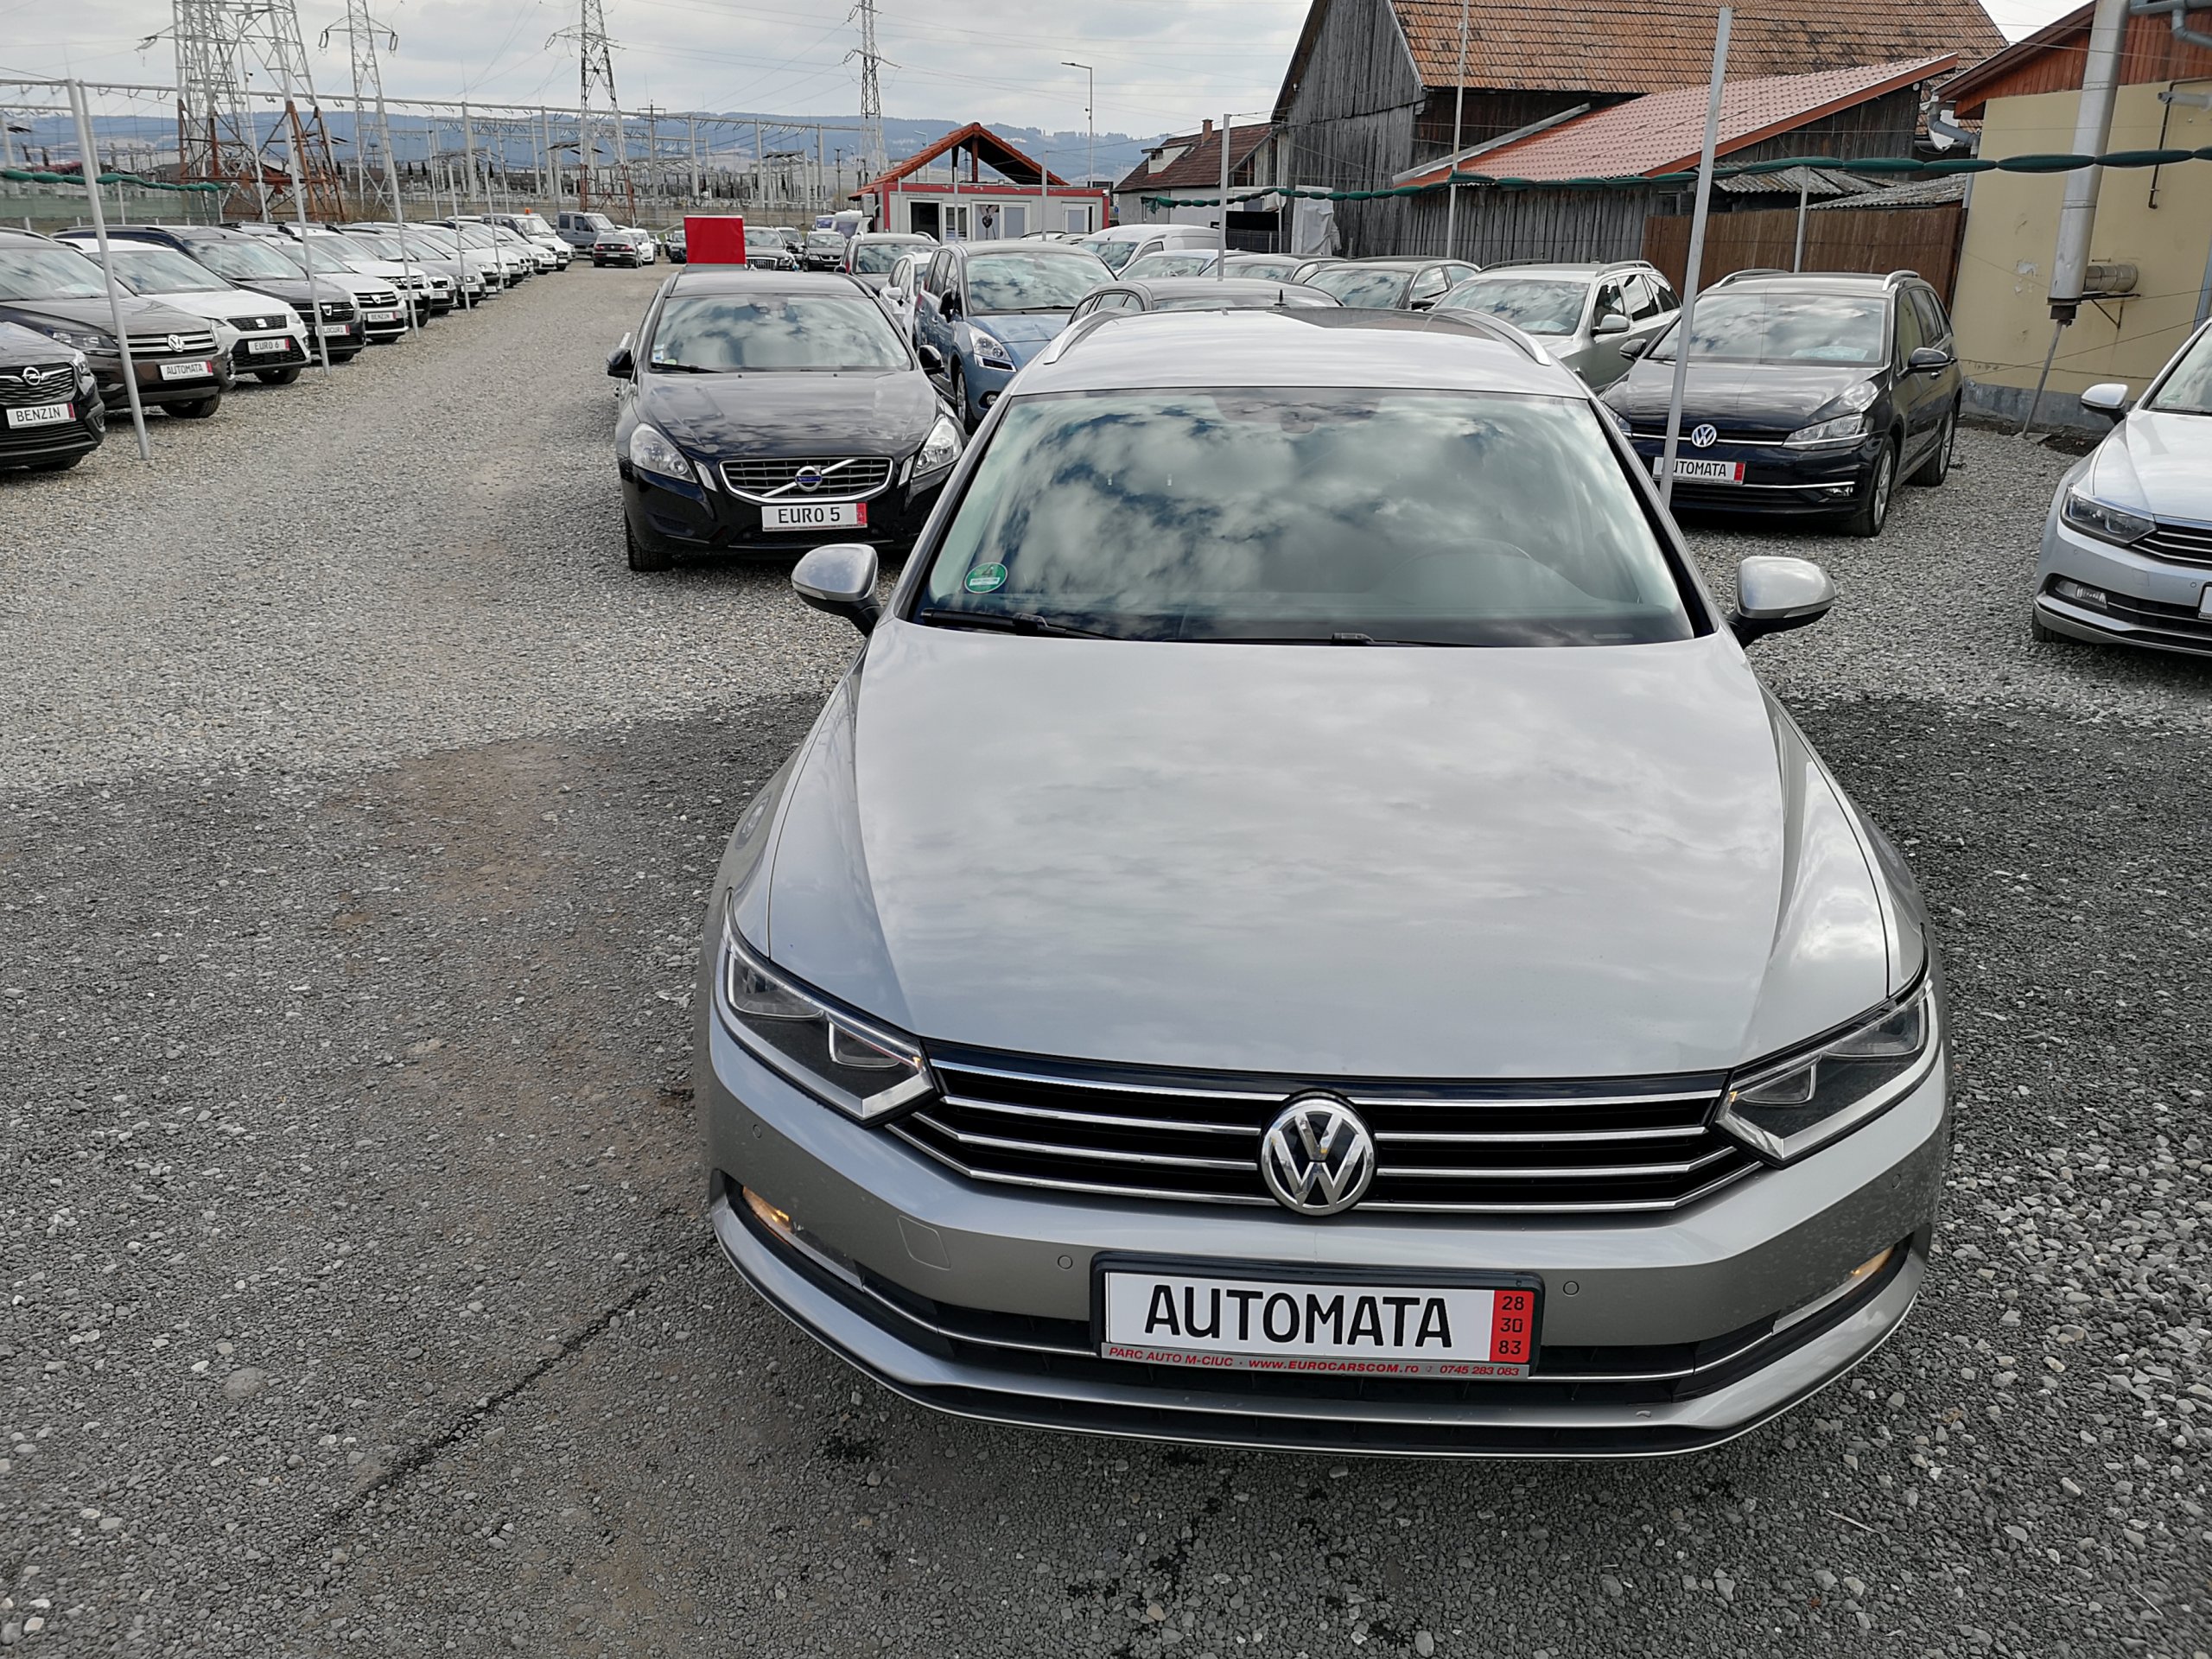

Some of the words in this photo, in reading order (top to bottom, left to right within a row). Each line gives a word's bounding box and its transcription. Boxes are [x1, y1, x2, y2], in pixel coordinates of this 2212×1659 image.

[254, 341, 274, 351] EURO
[166, 363, 204, 376] AUTOMATA
[16, 406, 61, 423] BENZIN
[1673, 460, 1726, 476] UTOMATA
[778, 508, 824, 524] EURO
[830, 506, 841, 522] 5
[1501, 1295, 1525, 1311] 28
[1144, 1284, 1452, 1348] AUTOMATA
[1499, 1318, 1523, 1333] 30
[1498, 1340, 1522, 1355] 83
[1109, 1347, 1143, 1360] PARC
[1147, 1351, 1182, 1363] AUTO
[1185, 1355, 1233, 1367] M-CIUC
[1249, 1359, 1419, 1373] www.EUROCARSCOM.ro
[1440, 1364, 1469, 1375] 0745
[1471, 1365, 1494, 1376] 283
[1497, 1366, 1520, 1376] 083
